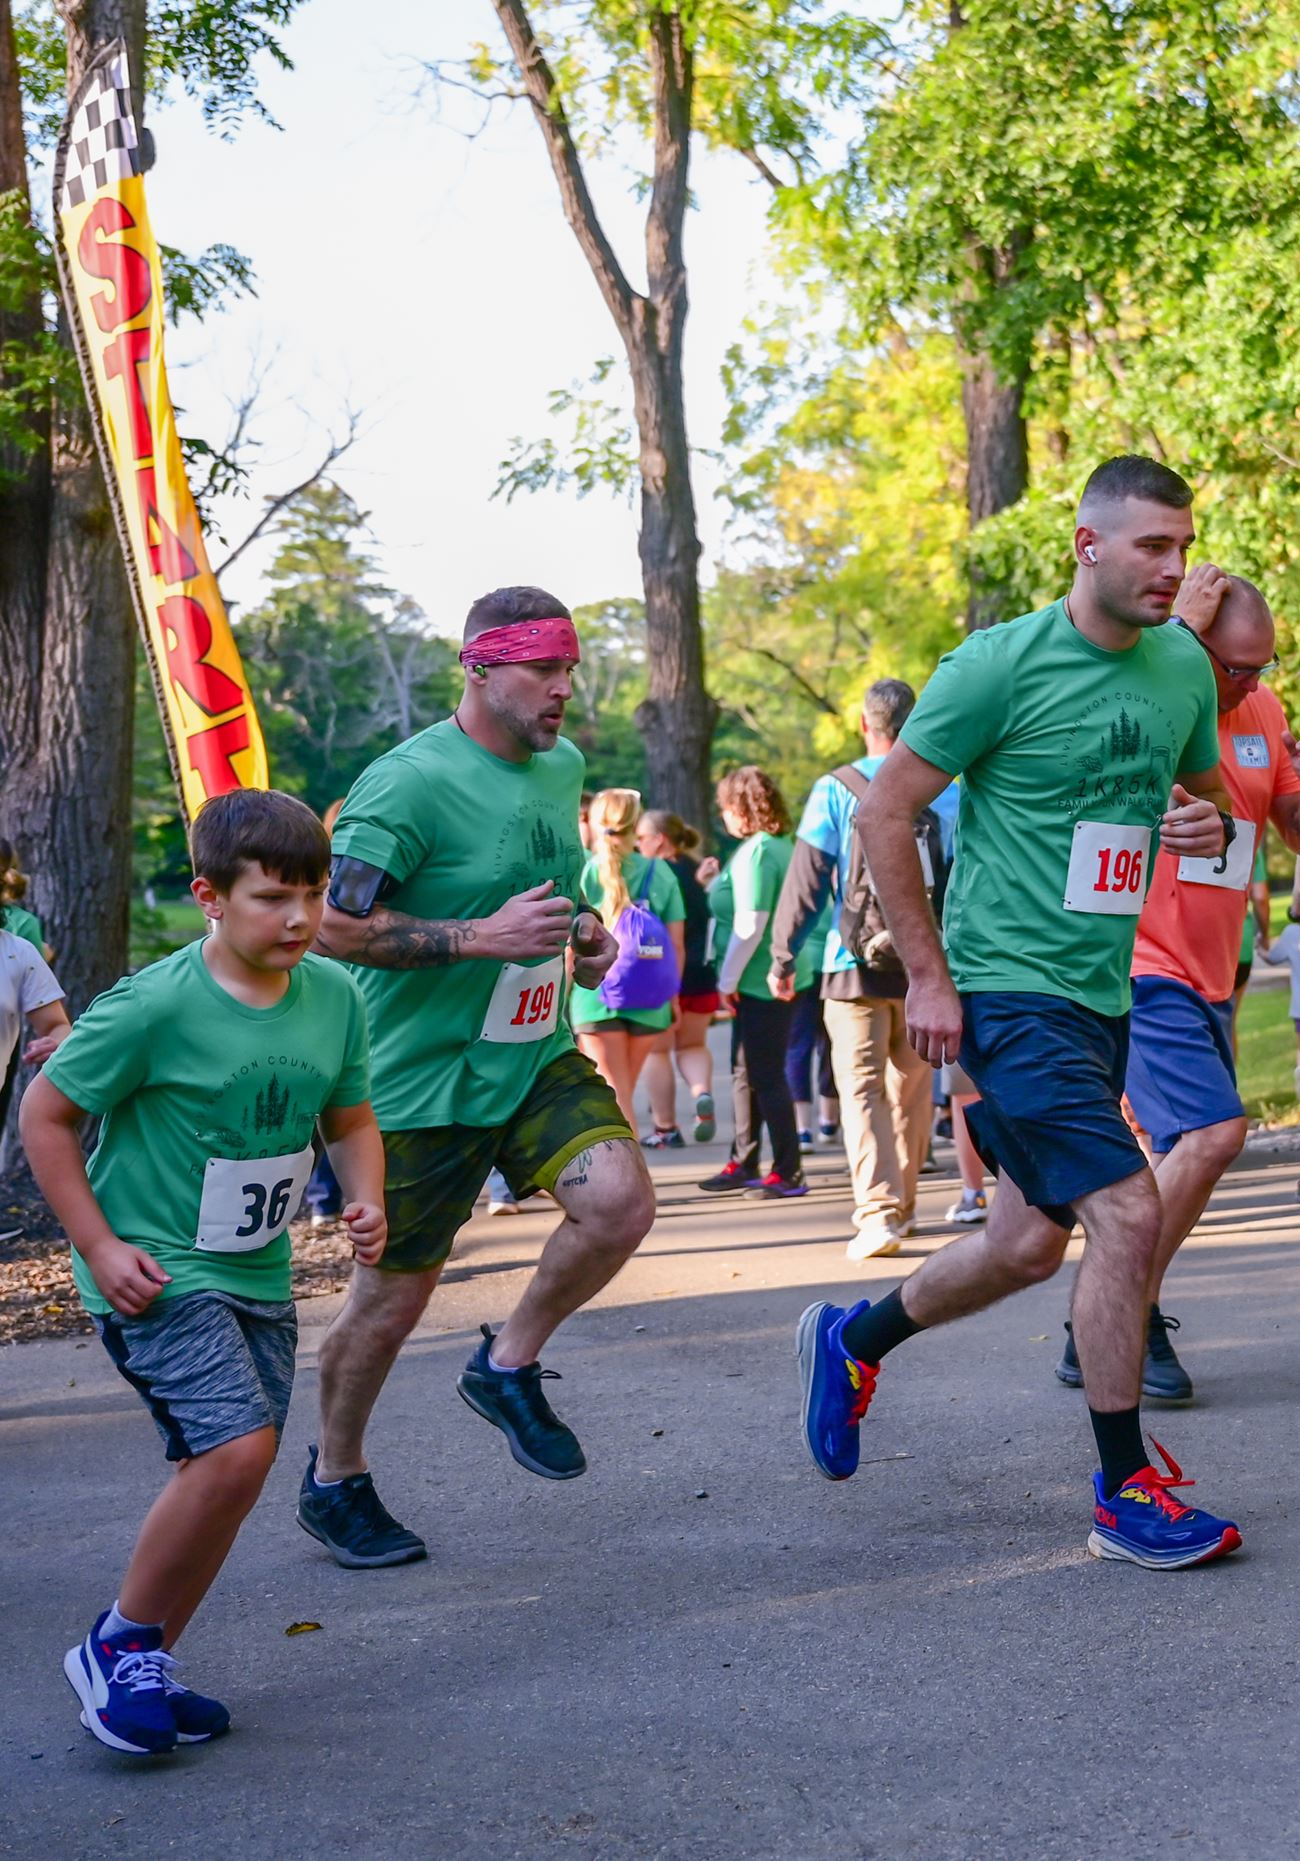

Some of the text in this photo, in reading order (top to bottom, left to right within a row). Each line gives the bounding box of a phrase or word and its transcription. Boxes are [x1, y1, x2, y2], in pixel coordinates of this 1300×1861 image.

[78, 197, 249, 799] START
[1114, 691, 1164, 714] COUNTY
[1093, 847, 1143, 893] 196
[510, 980, 555, 1025] 199
[267, 1055, 322, 1080] COUNTY
[235, 1177, 294, 1237] 36
